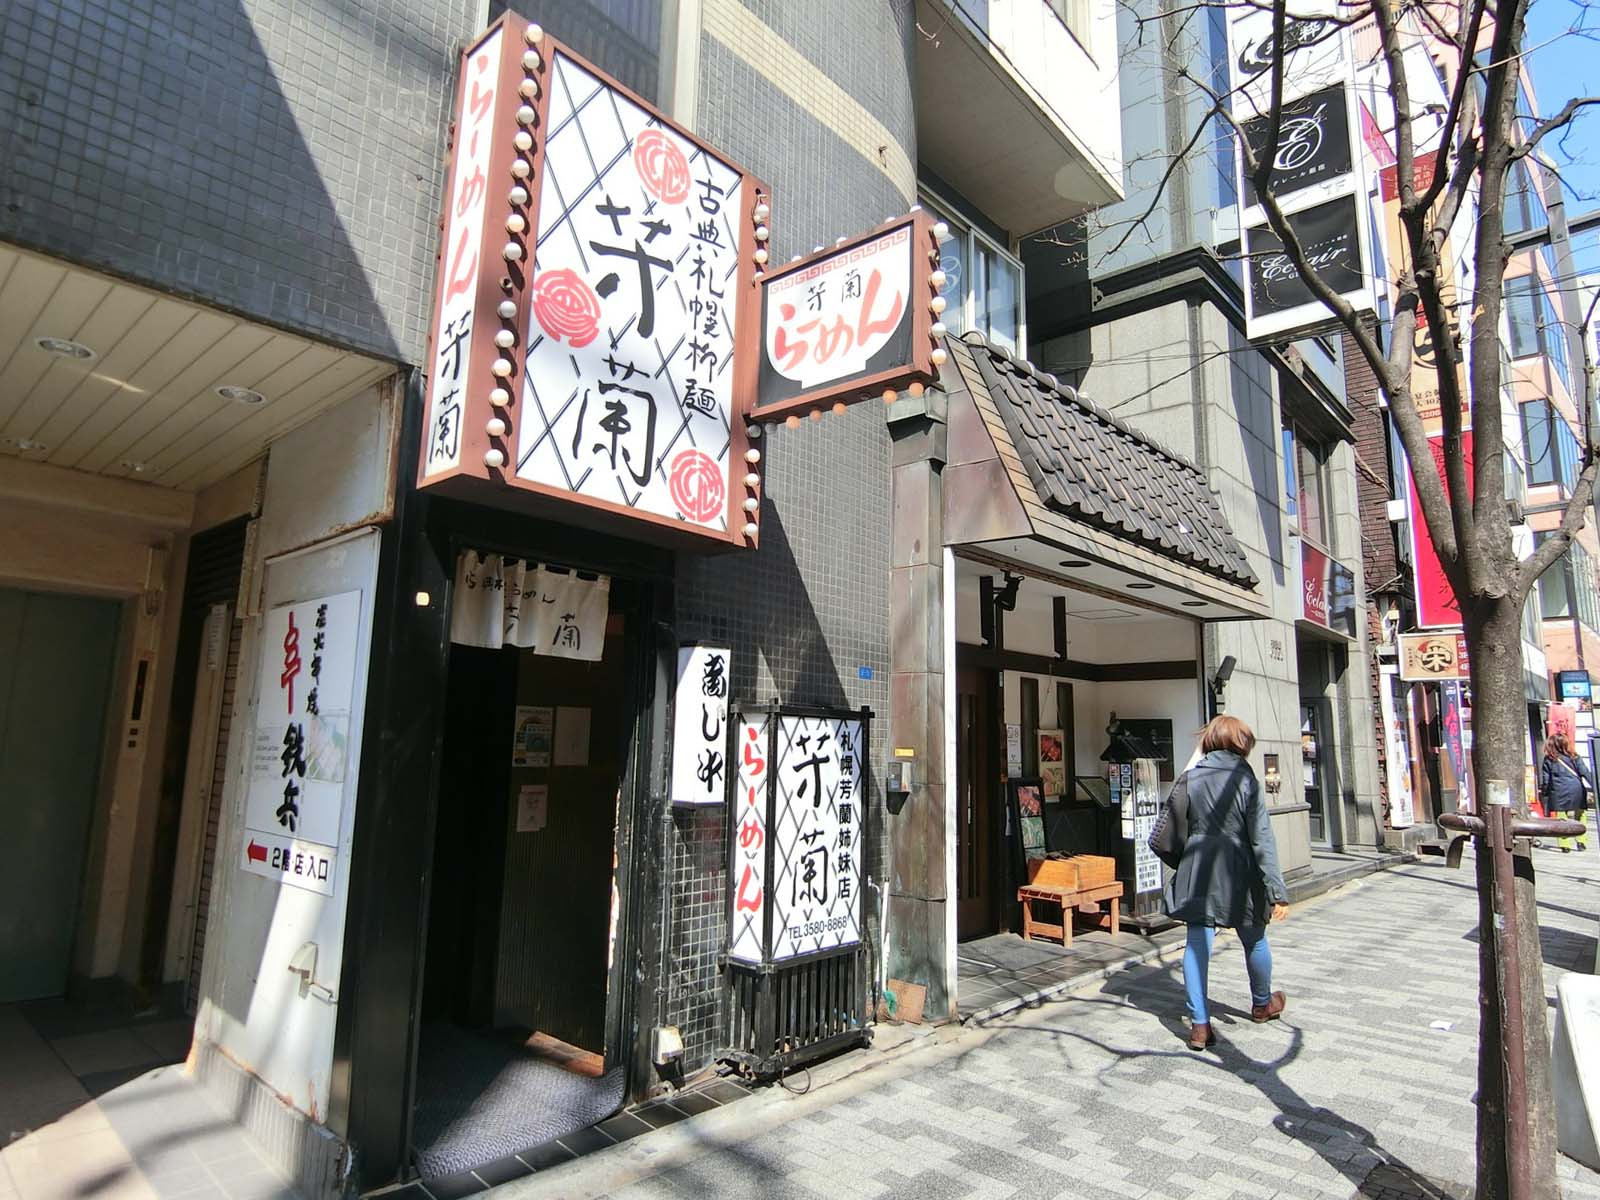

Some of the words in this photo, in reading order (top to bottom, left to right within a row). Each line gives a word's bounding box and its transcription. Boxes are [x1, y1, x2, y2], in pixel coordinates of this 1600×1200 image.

[736, 726, 766, 913] らーめん
[837, 730, 854, 900] 札幌芳蘭姉妹店
[788, 925, 803, 940] TEL
[803, 915, 848, 937] 3580-8868
